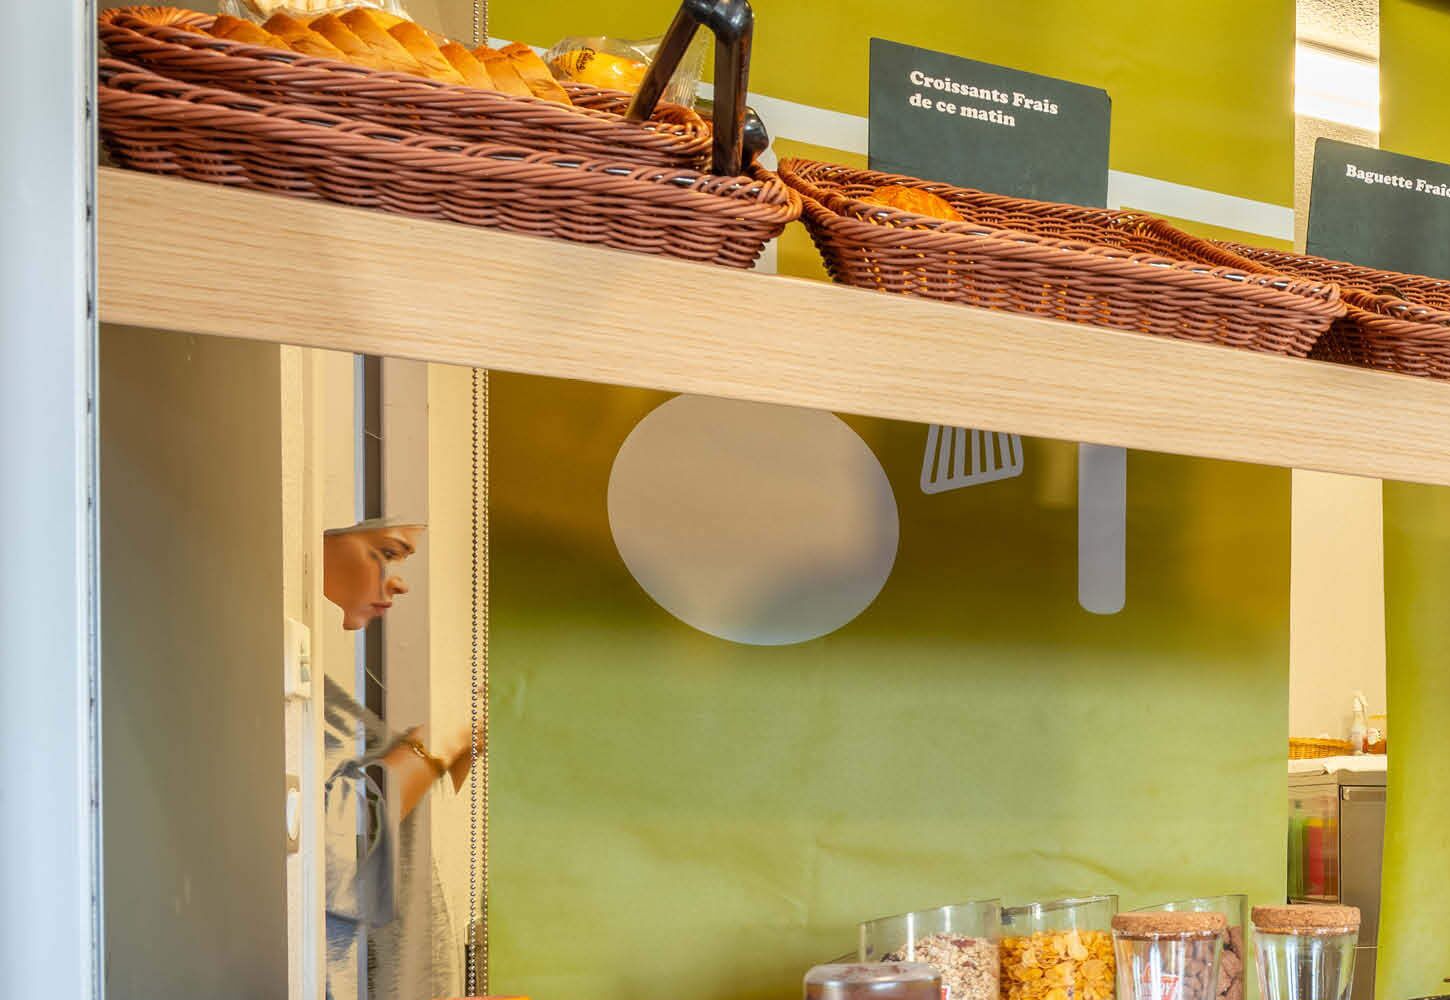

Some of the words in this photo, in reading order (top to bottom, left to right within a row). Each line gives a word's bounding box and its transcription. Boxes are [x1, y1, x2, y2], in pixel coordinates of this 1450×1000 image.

[909, 70, 1009, 105] Croissants
[1011, 91, 1059, 115] Frais
[908, 93, 933, 109] de
[935, 100, 957, 114] ce
[959, 105, 1016, 127] matin
[1345, 164, 1414, 189] Baguette
